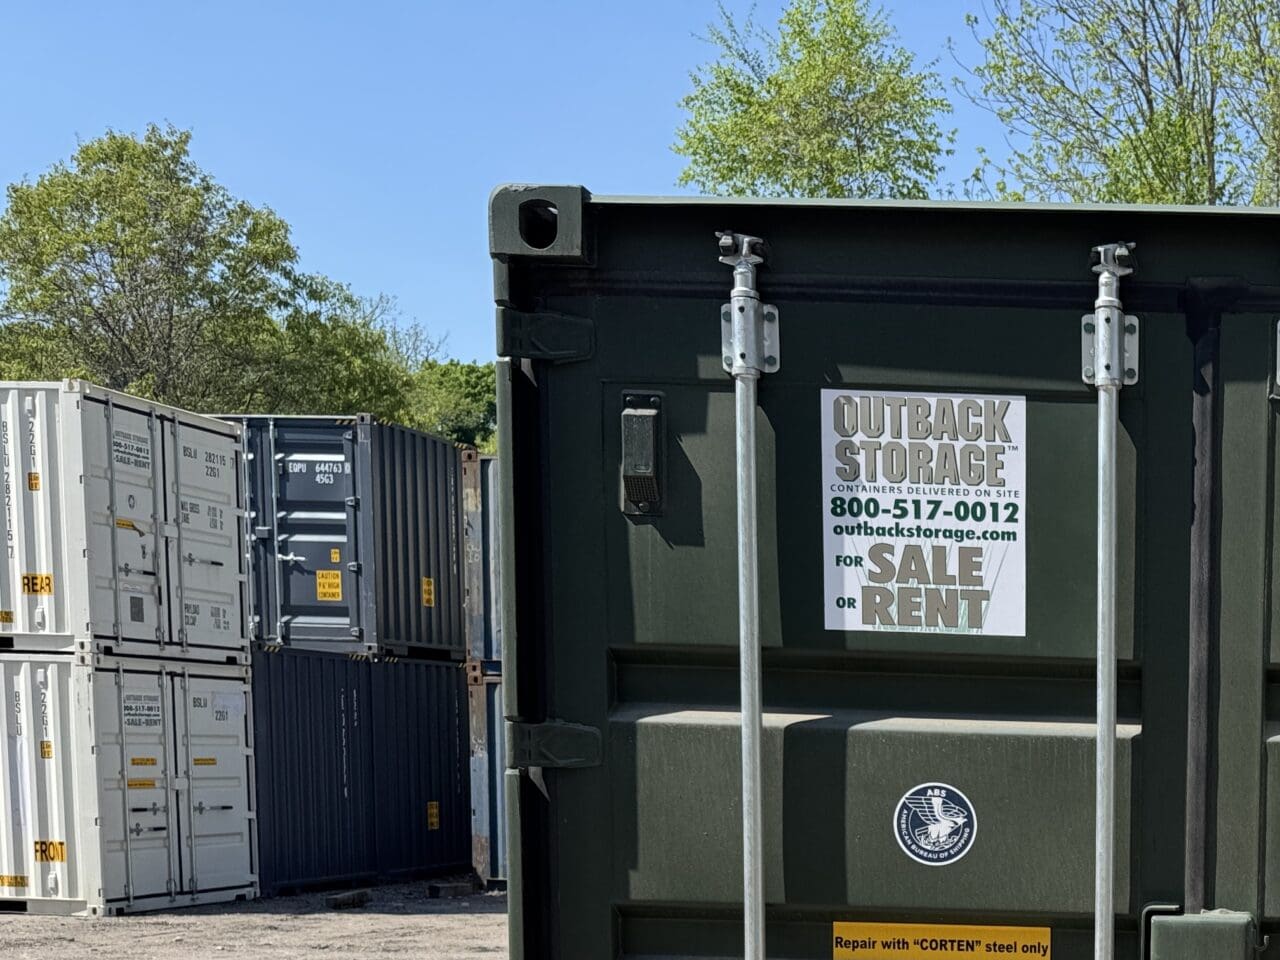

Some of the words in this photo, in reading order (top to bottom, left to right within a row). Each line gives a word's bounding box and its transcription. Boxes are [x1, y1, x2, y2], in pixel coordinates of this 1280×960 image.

[833, 395, 1012, 442] OUTBACK
[835, 439, 1006, 487] STORAGE
[830, 483, 903, 495] CONTAINERS
[907, 486, 970, 497] DELIVERED
[975, 489, 991, 498] ON
[996, 490, 1020, 498] SITE
[830, 497, 1019, 523] 800-517-0012
[833, 521, 1017, 542] outbackstorage.com
[835, 555, 863, 567] FOR
[867, 543, 983, 586] SALE
[22, 576, 52, 592] REAR
[836, 597, 857, 608] OR
[861, 586, 990, 628] RENT
[927, 788, 947, 797] ABS
[900, 809, 913, 845] AMERICAN
[910, 844, 938, 859] BUREAU
[939, 851, 949, 859] OF
[950, 827, 970, 855] SHIPPING
[34, 841, 65, 862] FRONT
[835, 936, 877, 951] Repair
[881, 938, 909, 950] with
[985, 941, 1017, 953] steel
[1021, 942, 1048, 957] only
